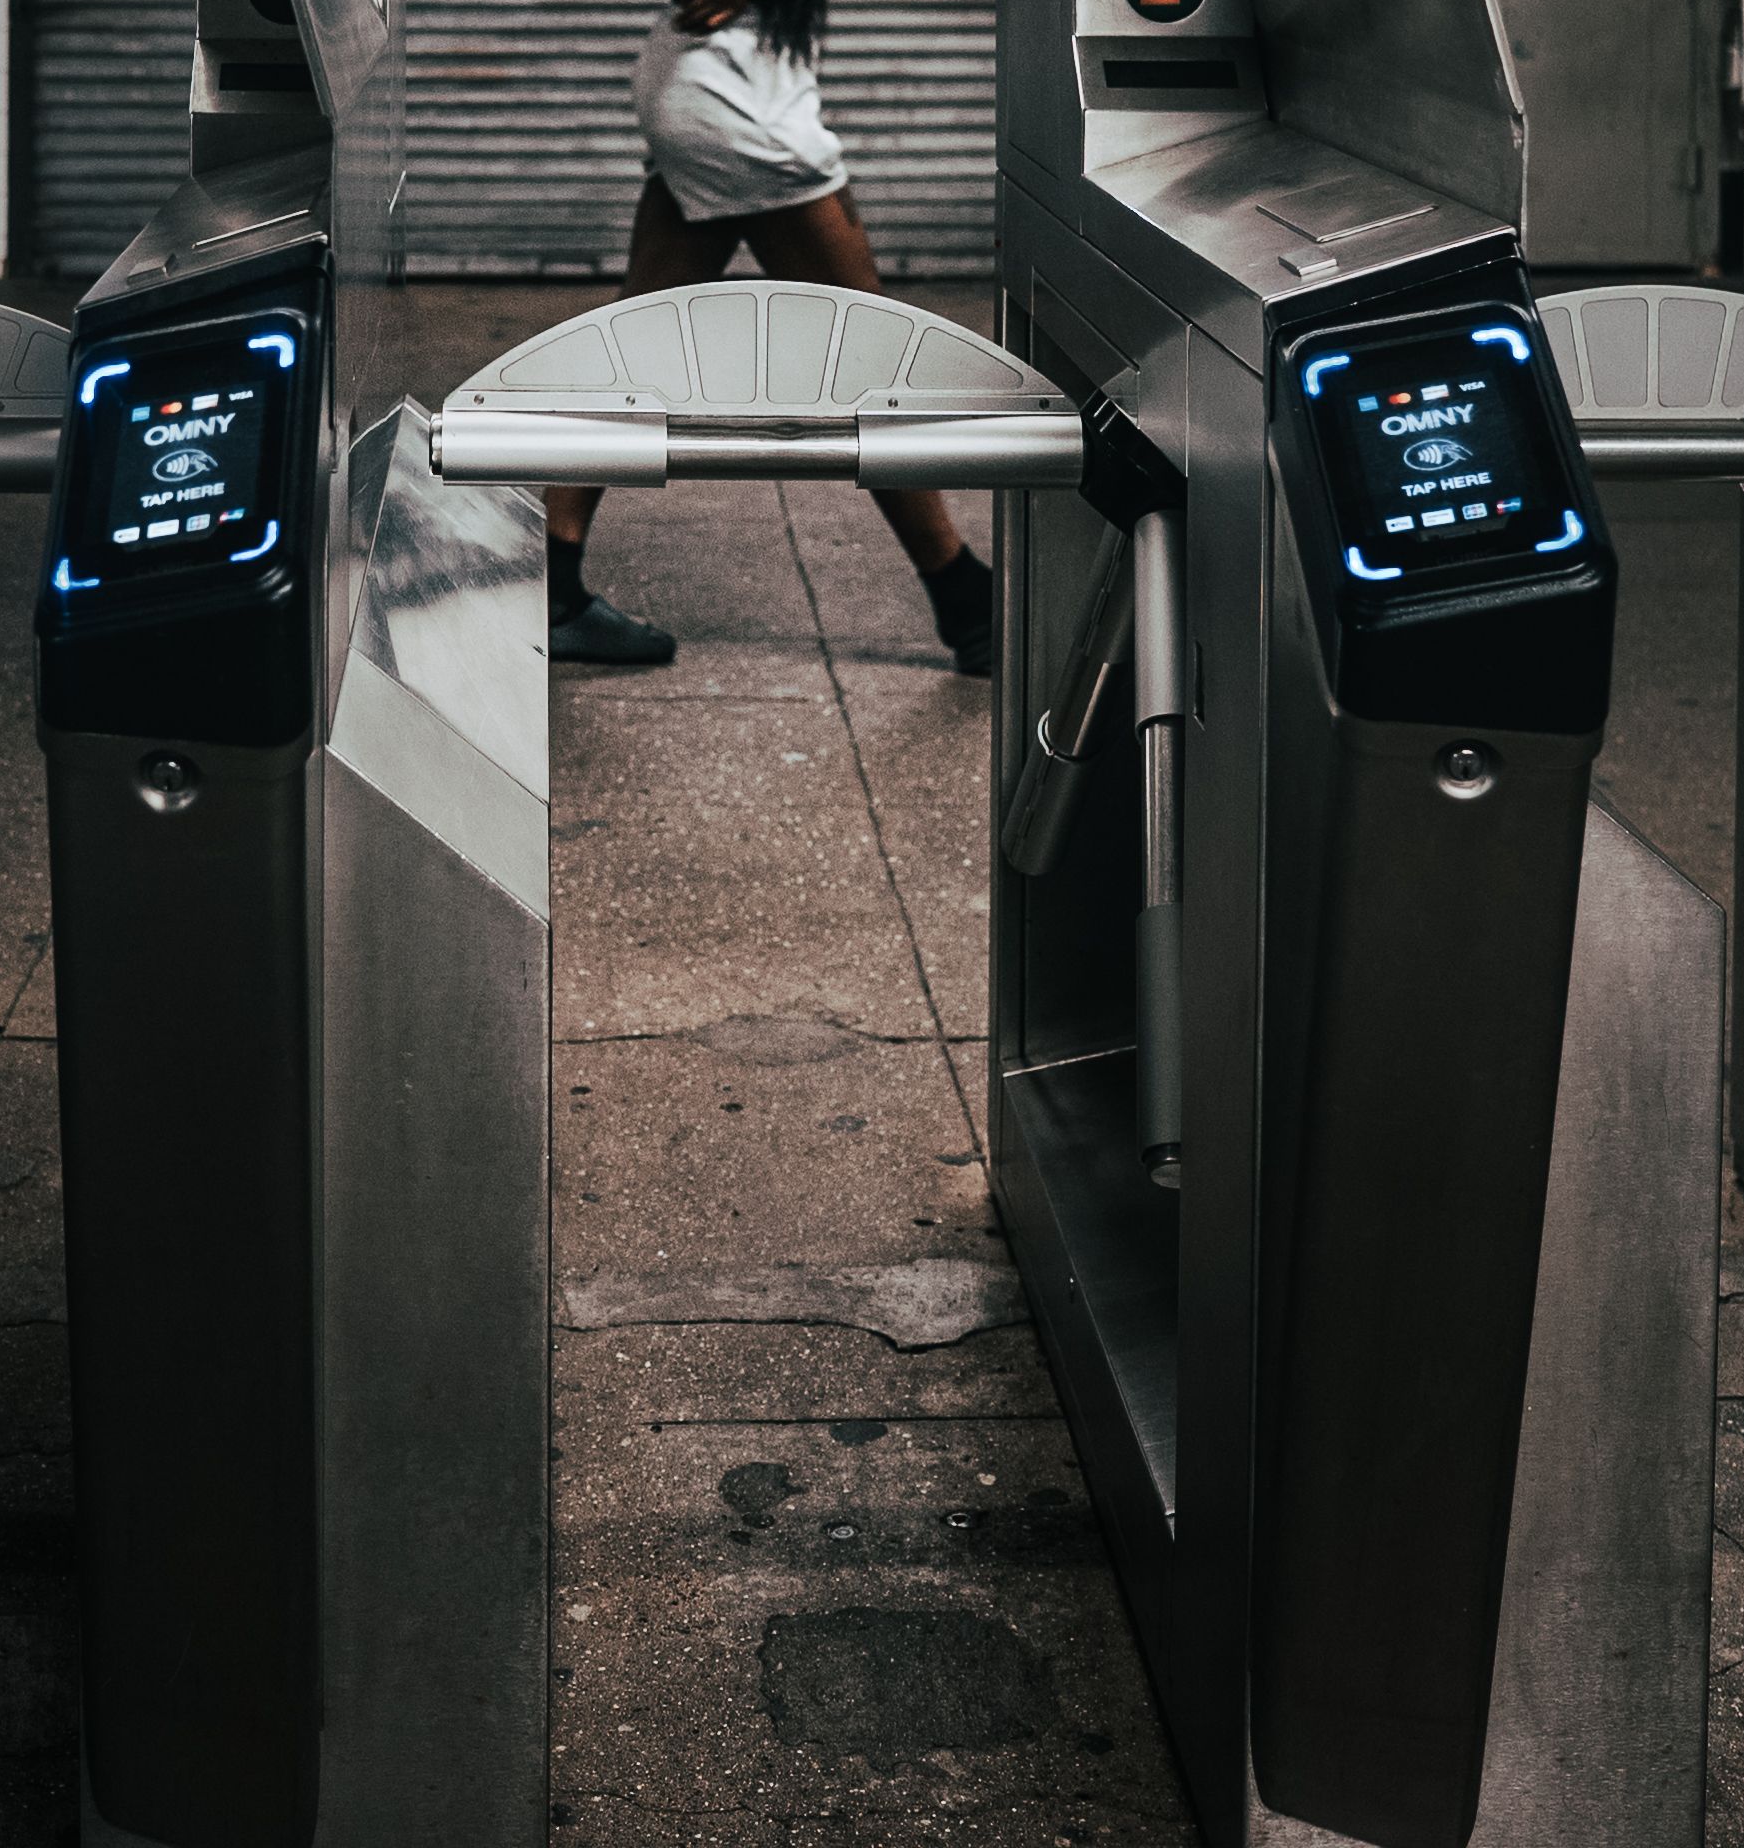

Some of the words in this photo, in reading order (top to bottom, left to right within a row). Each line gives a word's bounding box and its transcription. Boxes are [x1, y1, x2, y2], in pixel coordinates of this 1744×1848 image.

[1459, 380, 1486, 392] VISA
[143, 412, 236, 447] OMNY
[1381, 402, 1474, 436] OMNY
[140, 489, 174, 508] TAP
[176, 482, 225, 504] HERE
[1401, 479, 1437, 497] TAP
[1440, 471, 1492, 492] HERE
